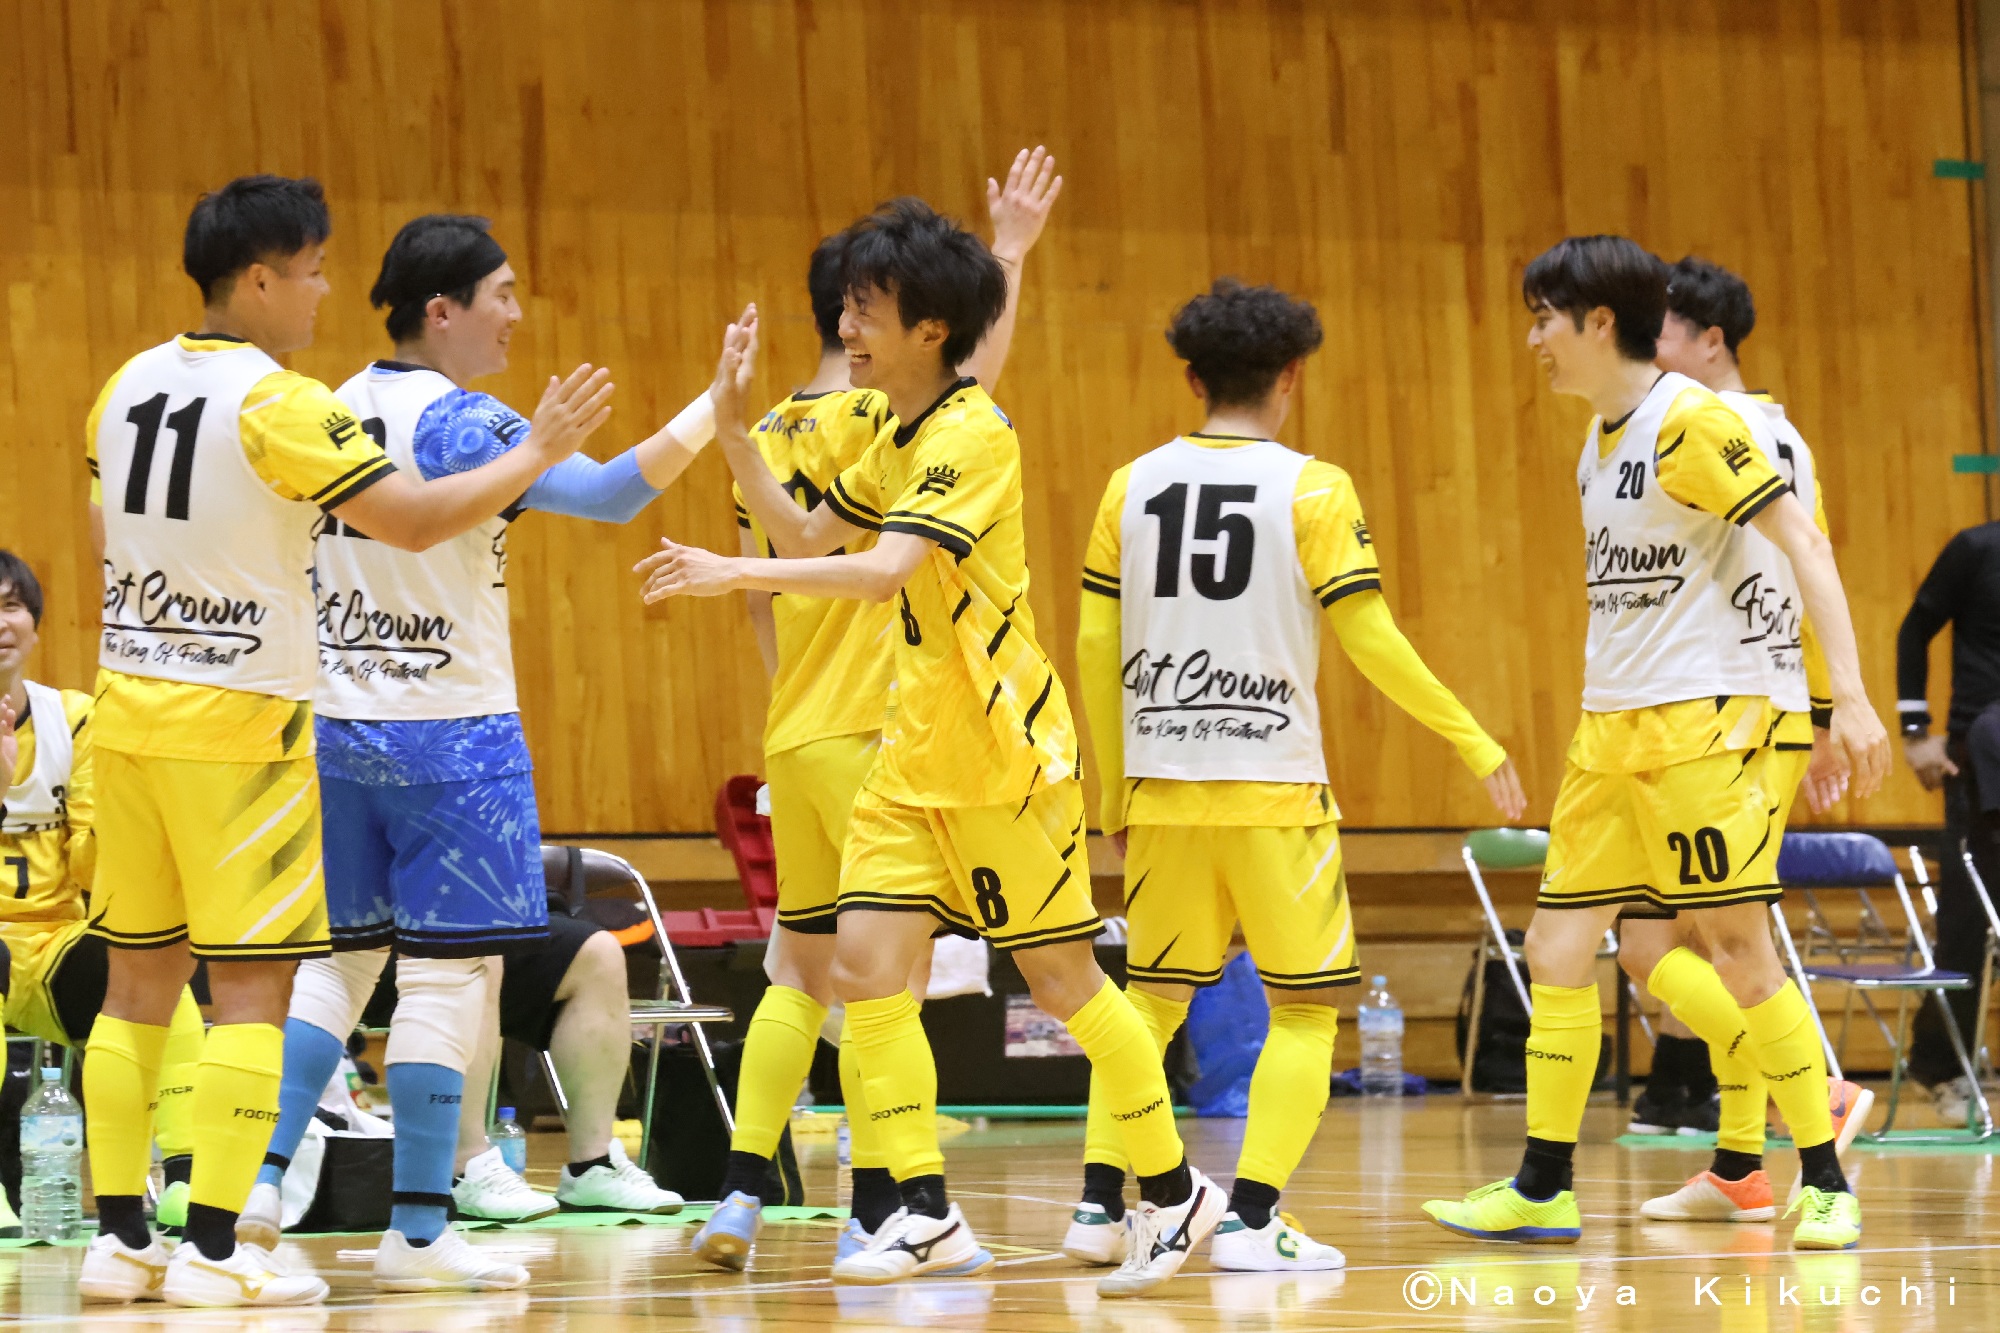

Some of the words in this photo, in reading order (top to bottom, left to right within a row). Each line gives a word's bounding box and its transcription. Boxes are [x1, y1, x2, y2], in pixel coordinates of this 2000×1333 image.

[124, 392, 206, 520] 11
[1616, 461, 1646, 500] 20
[1144, 482, 1257, 600] 15
[1595, 526, 1687, 580] Crown
[139, 570, 267, 625] Crown
[341, 589, 453, 644] Crown
[1174, 648, 1296, 704] Crown
[1668, 826, 1730, 885] 20
[971, 867, 1009, 928] 8
[1110, 1096, 1164, 1121] CROWN
